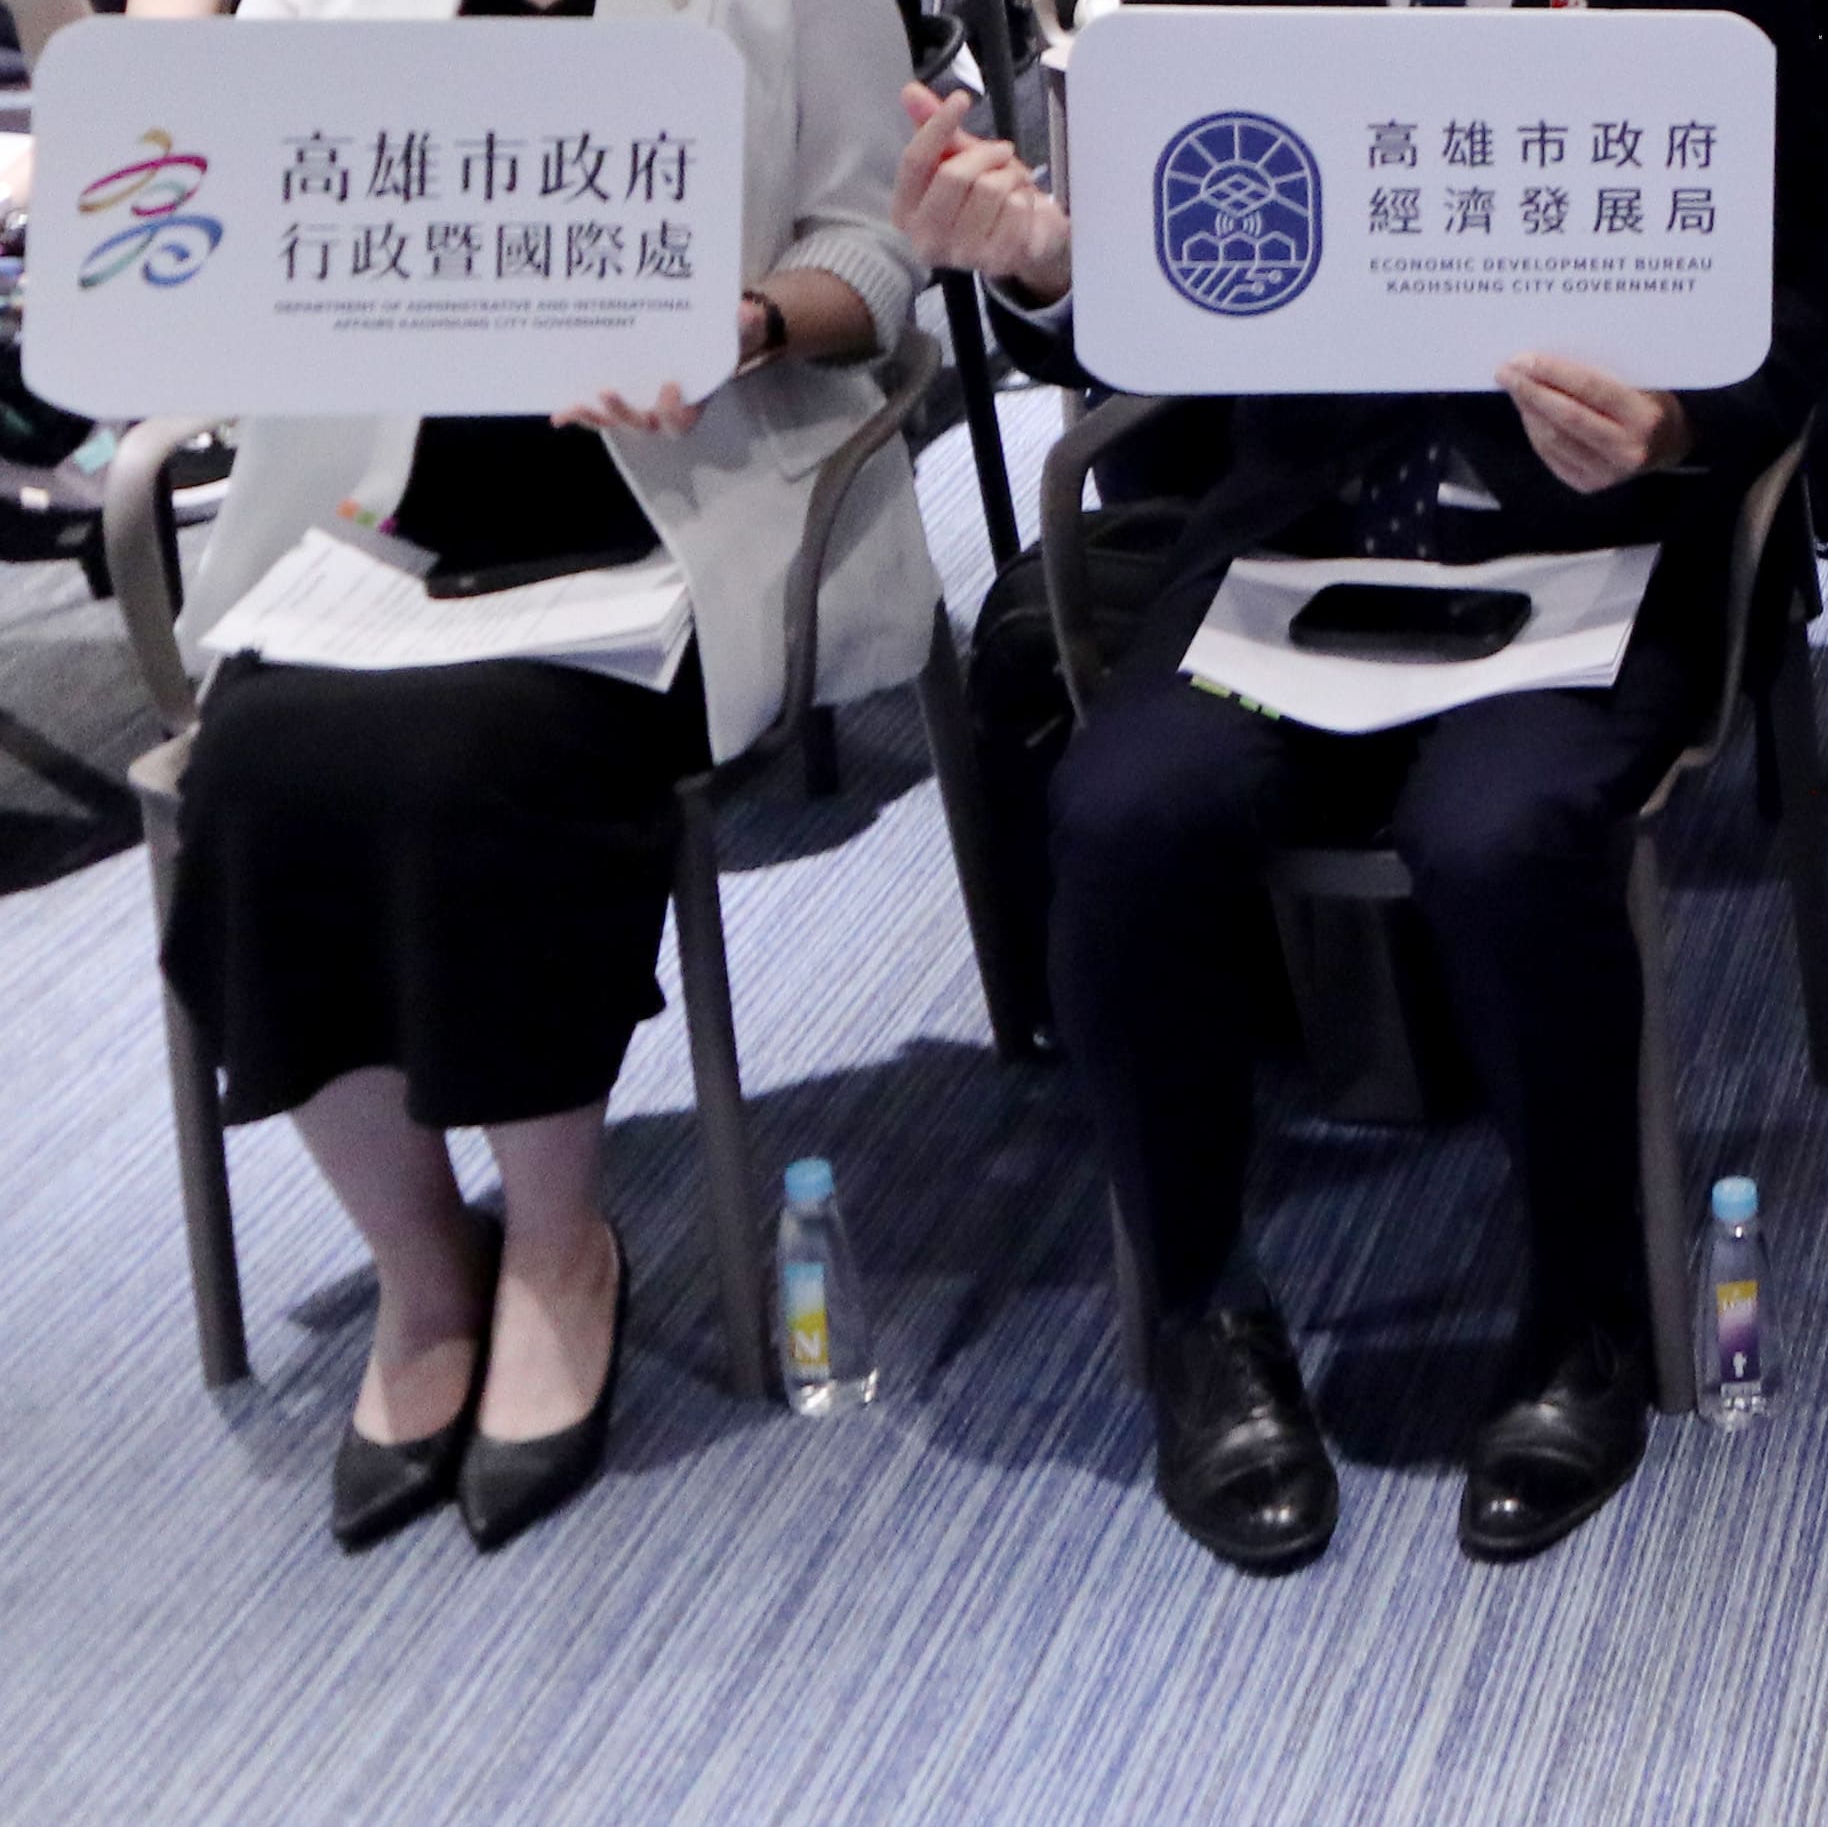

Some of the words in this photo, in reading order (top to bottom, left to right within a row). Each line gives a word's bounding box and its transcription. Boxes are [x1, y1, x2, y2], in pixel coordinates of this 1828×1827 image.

[282, 130, 696, 203] 高雄市政府
[1367, 118, 1717, 169] 高雄市政府
[1368, 186, 1716, 235] 經濟發展局
[281, 218, 694, 280] 行政暨國際處
[1369, 257, 1474, 271] ECONOMIC
[1483, 257, 1627, 271] DEVELOPMENT
[1635, 256, 1713, 271] BUREAU
[274, 298, 377, 313] DEPARTMENT
[381, 298, 400, 312] OF
[407, 298, 531, 311] ADMINISTRATIVE
[538, 298, 568, 311] AND
[573, 296, 692, 311] INTERNATIONAL
[1386, 278, 1504, 294] KAOHSIUNG
[1512, 278, 1555, 293] CITY
[1562, 278, 1697, 294] GOVERNMENT
